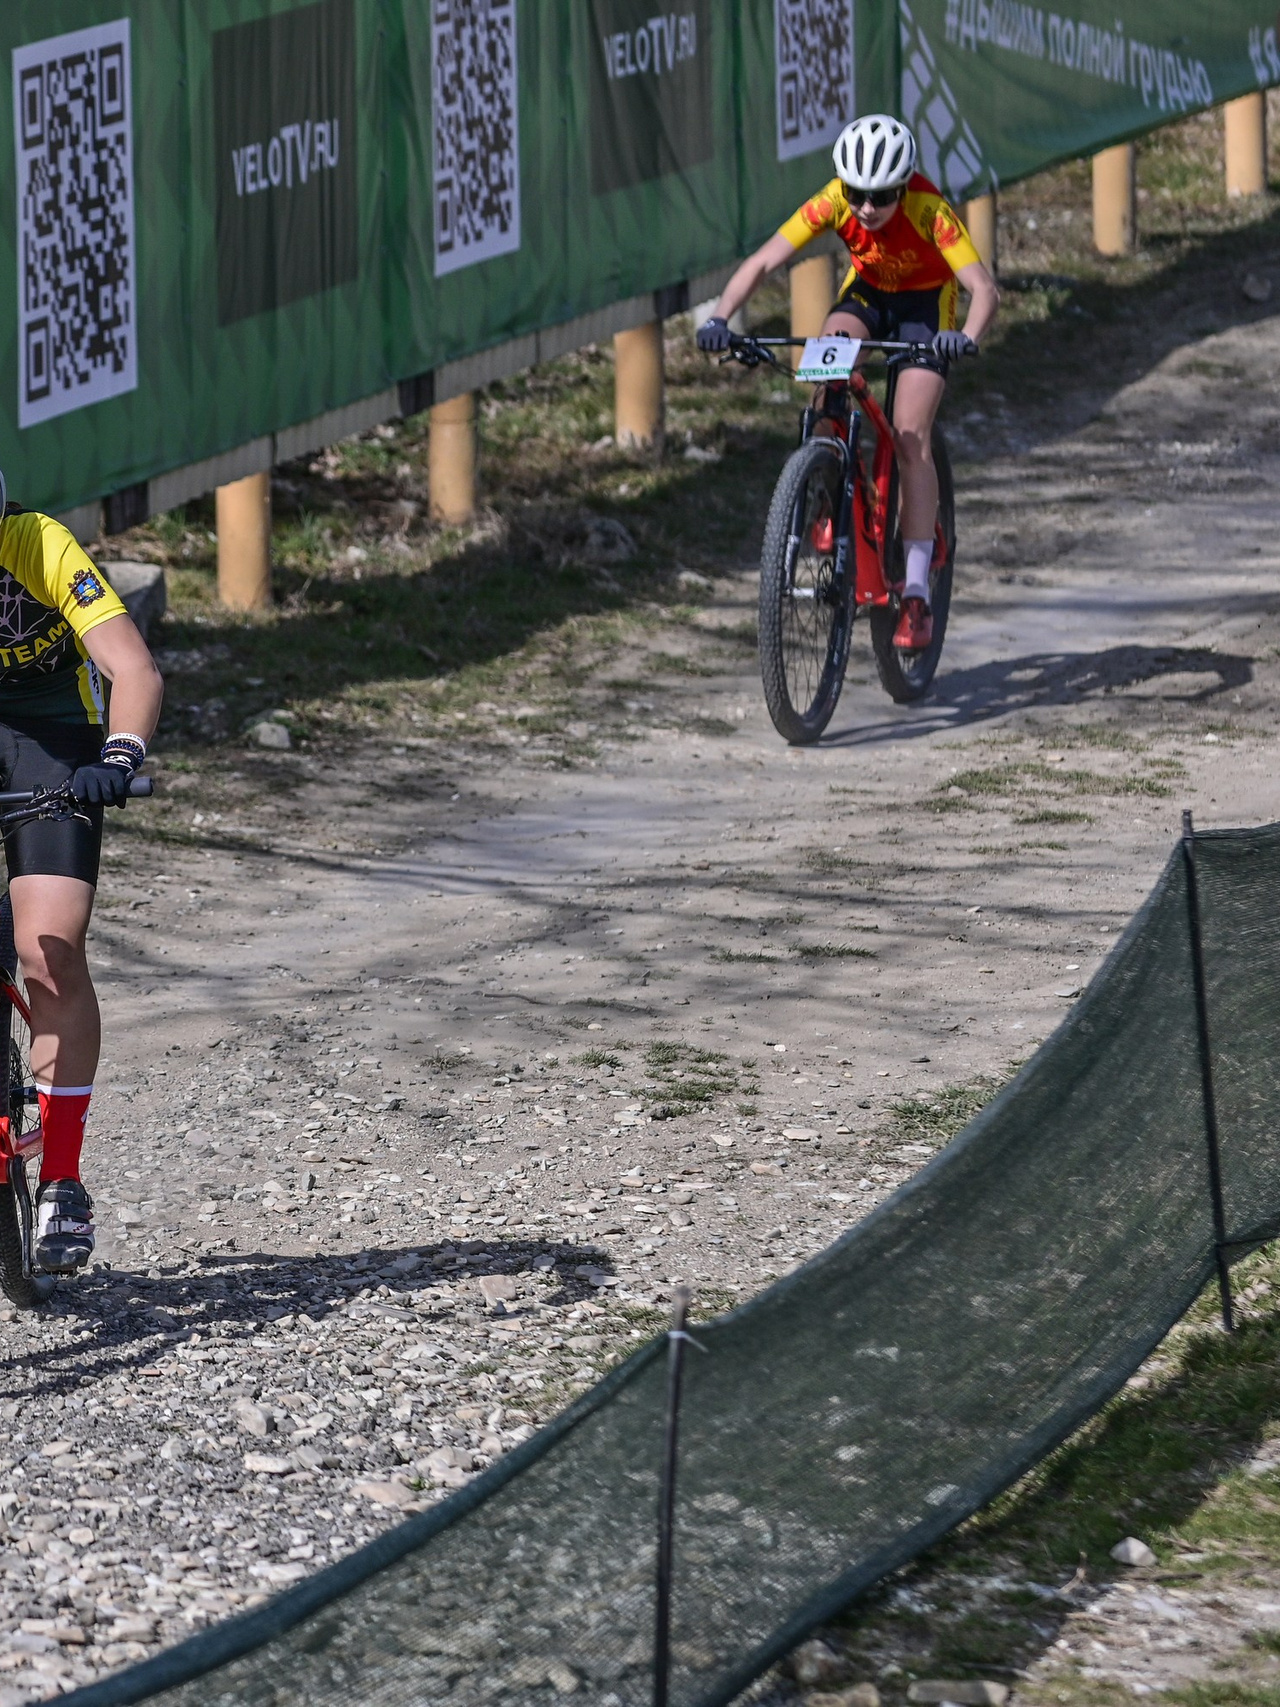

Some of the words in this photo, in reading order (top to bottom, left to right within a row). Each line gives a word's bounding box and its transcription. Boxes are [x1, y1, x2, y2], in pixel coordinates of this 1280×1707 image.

[602, 12, 697, 79] VELOTV.RU
[1048, 12, 1126, 86] ПОЛНОЙ
[1129, 38, 1213, 112] ГРУДЬЮ
[232, 117, 339, 197] VELOTV.RU
[822, 346, 838, 365] 6
